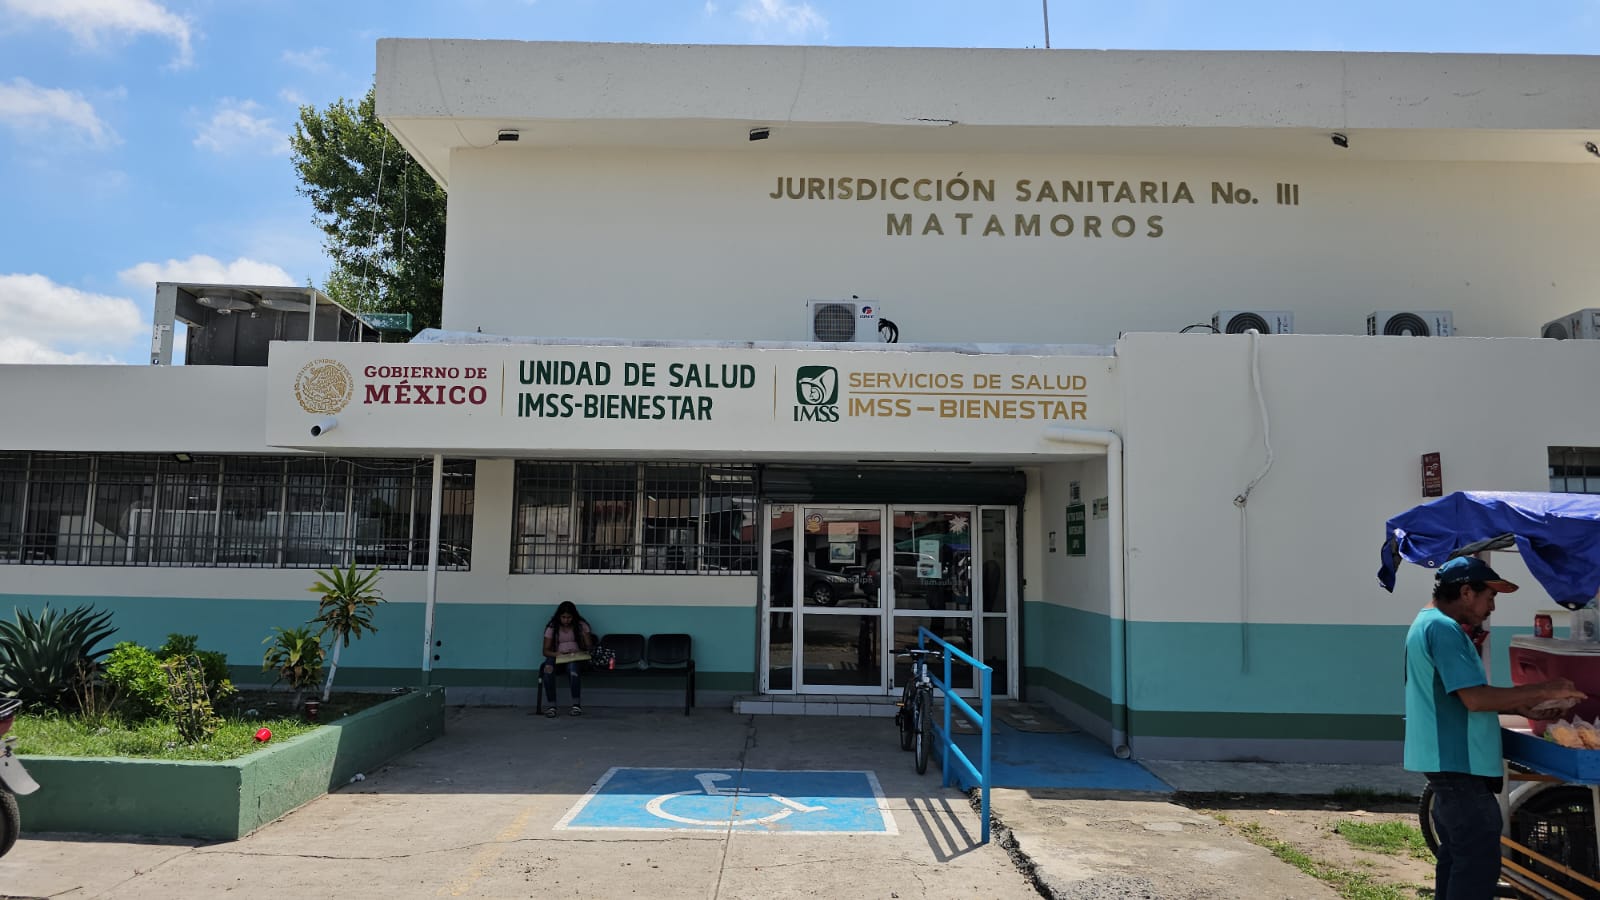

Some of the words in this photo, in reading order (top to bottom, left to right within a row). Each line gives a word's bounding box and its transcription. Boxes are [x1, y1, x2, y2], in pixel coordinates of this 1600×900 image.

[769, 172, 996, 201] JURISDICCIÓN
[1015, 179, 1195, 205] SANITARIA
[1211, 182, 1259, 205] No.
[1276, 183, 1300, 206] III
[886, 213, 1165, 239] MATAMOROS
[364, 365, 459, 380] GOBIERNO
[463, 367, 488, 380] DE
[519, 359, 612, 386] UNIDAD
[623, 361, 656, 388] DE
[668, 363, 757, 390] SALUD
[848, 372, 964, 390] SERVICIOS
[973, 373, 1002, 390] DE
[1010, 374, 1088, 391] SALUD
[363, 380, 488, 405] MÉXICO
[517, 392, 713, 421] IMSS-BIENESTAR
[793, 404, 840, 423] IMSS
